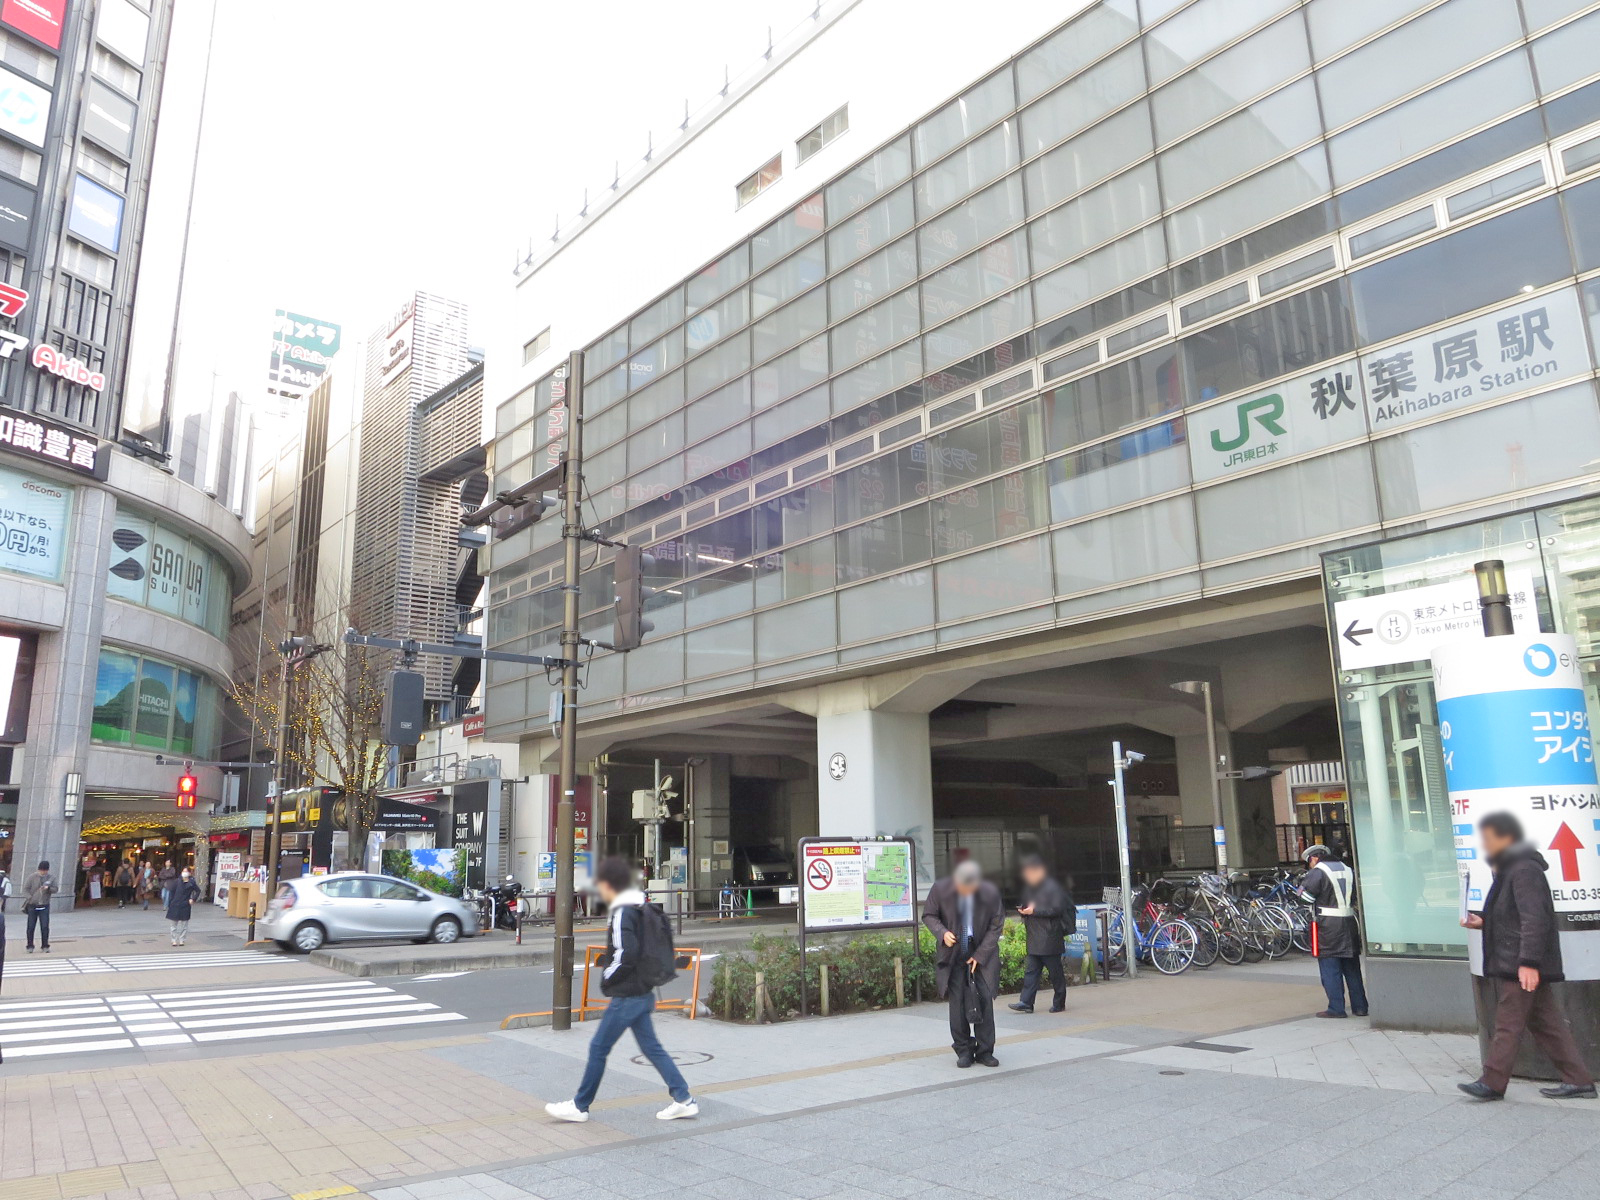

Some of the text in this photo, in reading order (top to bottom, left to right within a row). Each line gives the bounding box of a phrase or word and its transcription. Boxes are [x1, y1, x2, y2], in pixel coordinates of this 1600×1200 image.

[33, 344, 105, 391] Akiba
[1311, 307, 1554, 421] 秋葉原駅
[1375, 358, 1558, 424] Akihabara Station
[1210, 393, 1288, 452] JR
[1223, 442, 1279, 468] JR東日本
[22, 480, 62, 498] docomo
[150, 577, 201, 609] SUPLY
[1413, 591, 1527, 621] 東京メトロ線
[1389, 617, 1398, 627] H
[1416, 624, 1441, 636] Tokyo
[1444, 620, 1470, 632] Metro
[1387, 627, 1402, 639] 15
[1440, 720, 1452, 740] の
[456, 813, 468, 825] THE
[455, 828, 469, 839] SUIT
[454, 842, 483, 854] COMPANY
[540, 854, 551, 867] P
[1552, 888, 1600, 901] EL.03-35
